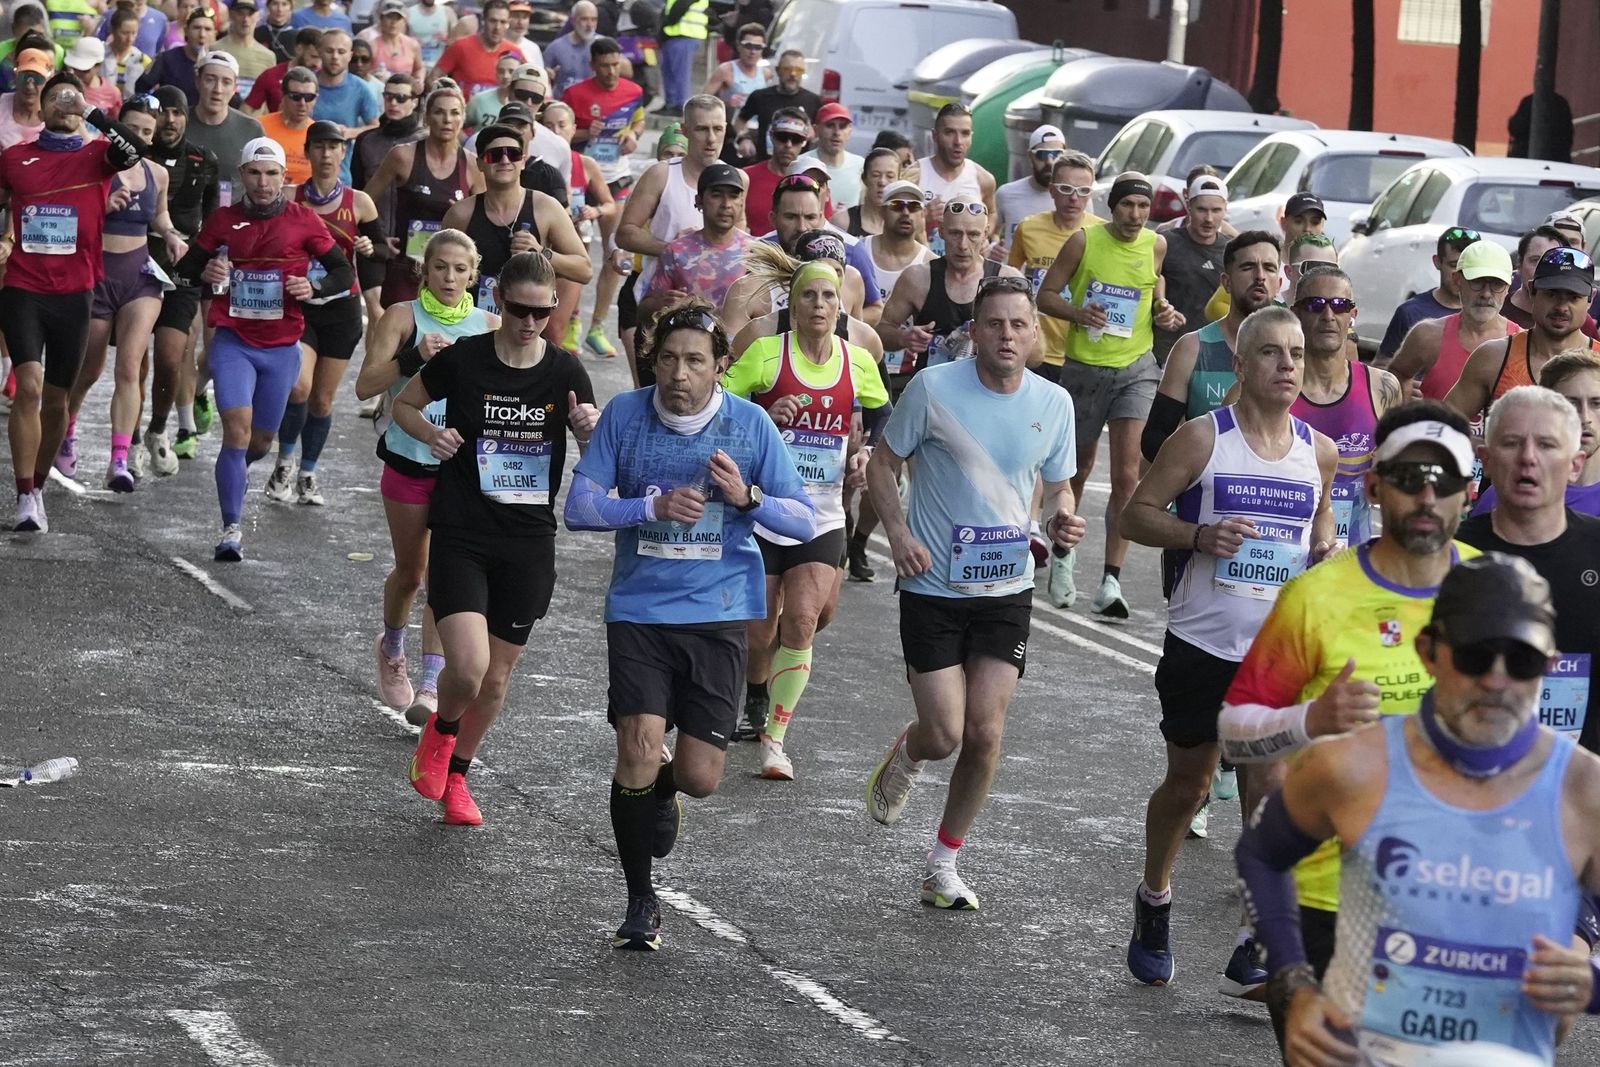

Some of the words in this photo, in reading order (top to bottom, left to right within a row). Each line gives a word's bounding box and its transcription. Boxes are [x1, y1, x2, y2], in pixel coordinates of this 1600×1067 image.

[1104, 286, 1136, 298] ZURICH
[483, 429, 502, 437] MORE
[503, 430, 520, 439] THAN
[520, 431, 543, 440] STORES
[798, 434, 836, 447] ZURICH
[502, 442, 544, 454] ZURICH
[798, 452, 818, 463] 7102
[502, 461, 524, 471] 9482
[795, 464, 826, 481] ONIA
[491, 474, 538, 488] HELENE
[1227, 484, 1257, 496] ROAD
[1260, 487, 1307, 502] RUNNERS
[1241, 497, 1262, 505] CLUB
[1264, 499, 1295, 510] MILANO
[639, 529, 670, 542] MARIA
[673, 532, 680, 542] Y
[682, 532, 722, 543] BLANCA
[980, 529, 1021, 541] ZURICH
[980, 551, 1003, 561] 6306
[1250, 547, 1275, 561] 6543
[962, 562, 1017, 580] STUART
[1227, 561, 1290, 584] GIORGIO
[1374, 672, 1421, 687] CLUB
[1423, 945, 1508, 972] ZURICH
[1422, 986, 1468, 1010] 7123
[1401, 1009, 1478, 1043] GABO
